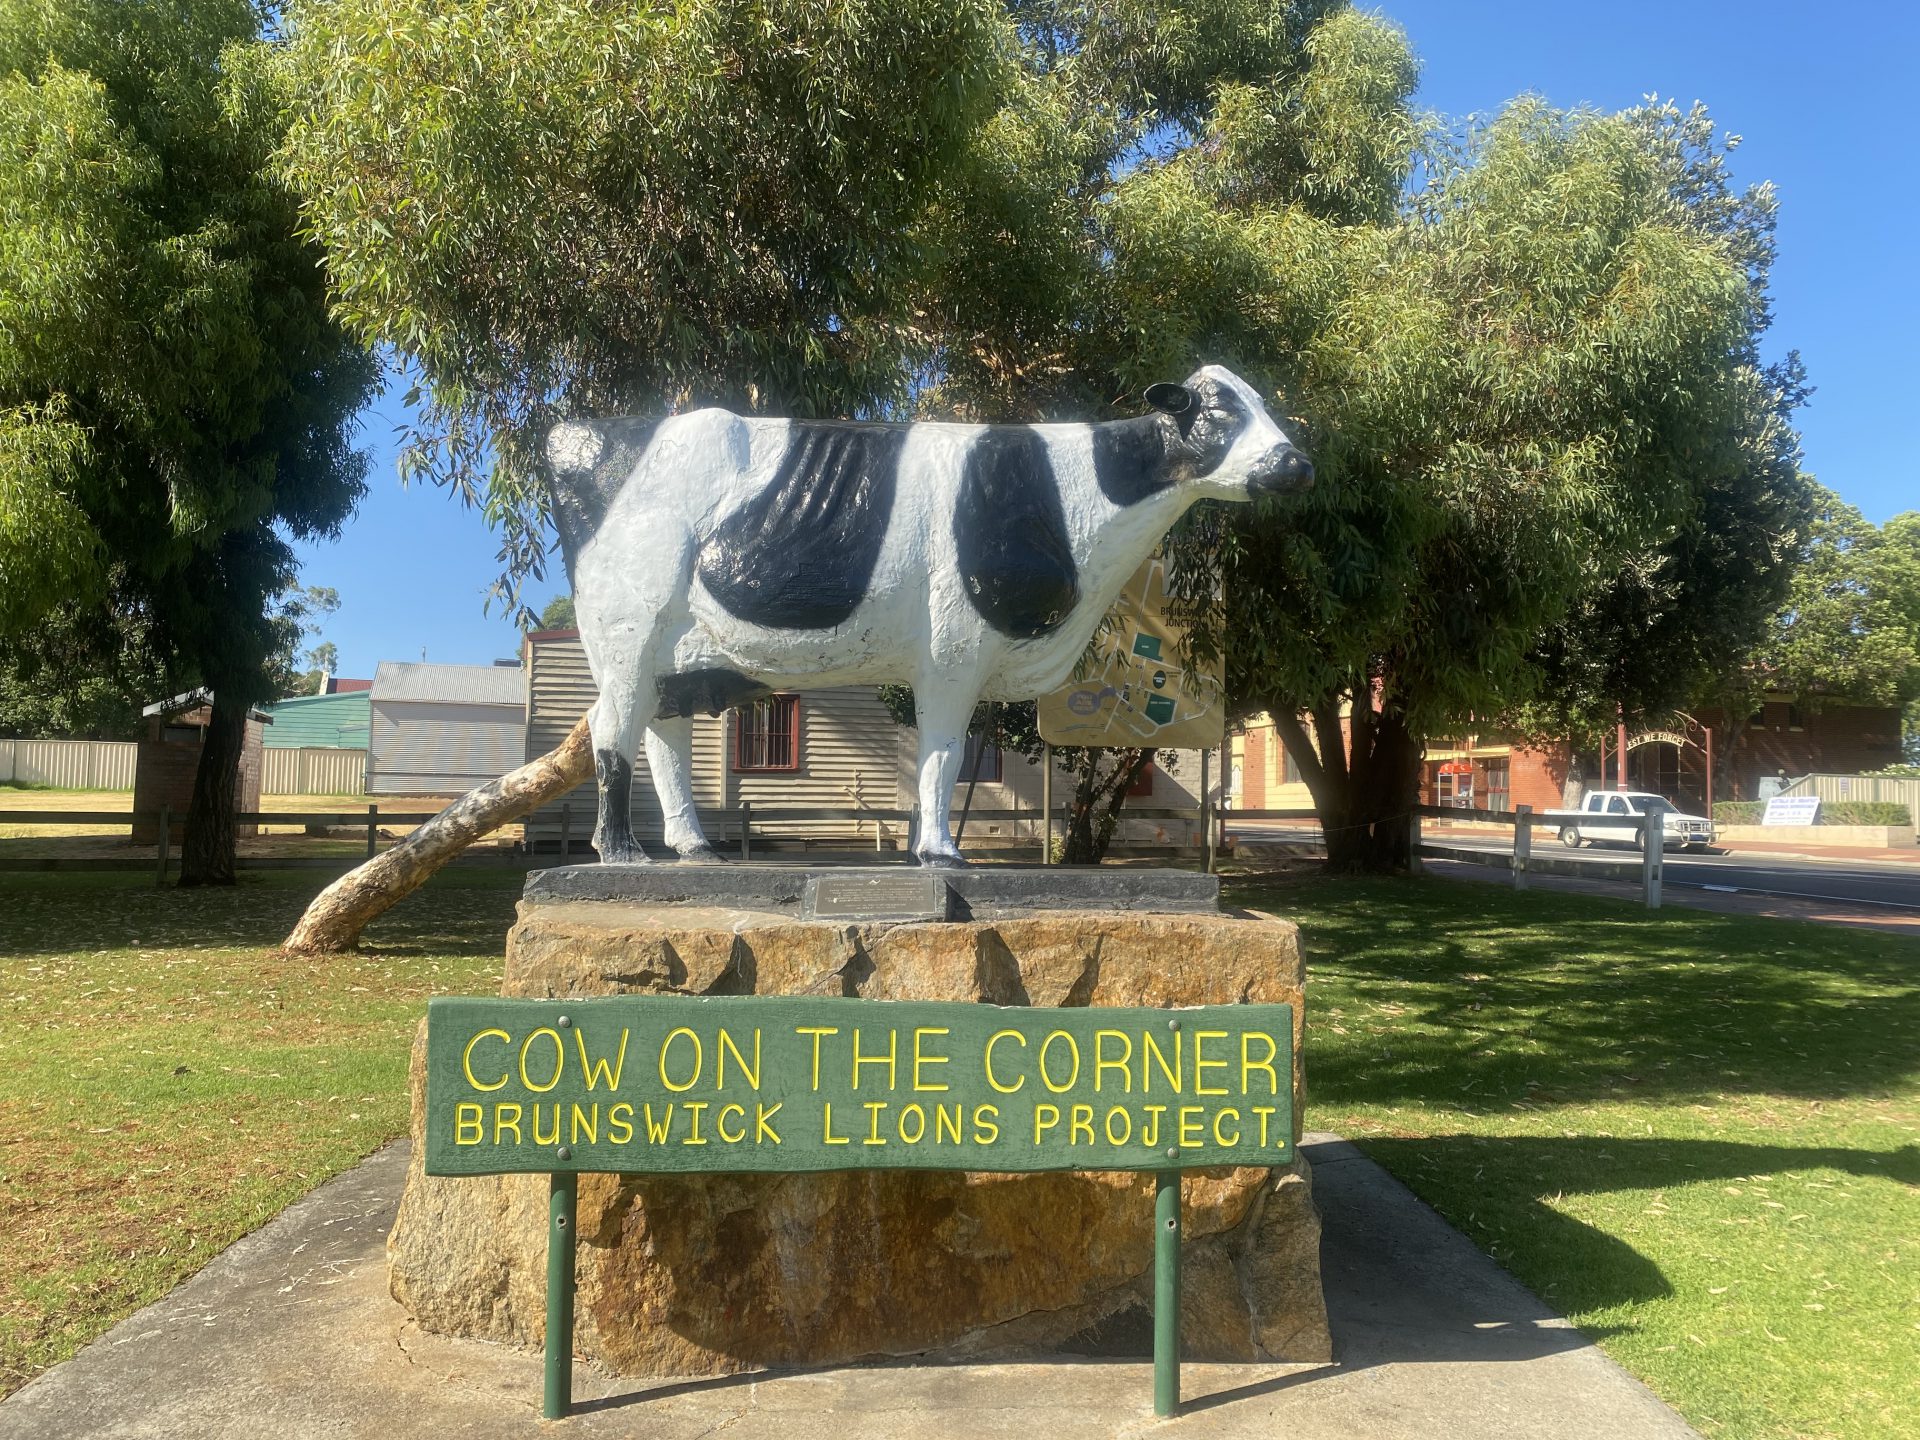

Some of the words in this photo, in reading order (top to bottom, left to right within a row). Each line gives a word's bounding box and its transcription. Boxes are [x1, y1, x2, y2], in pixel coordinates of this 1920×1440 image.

[1627, 736, 1641, 748] EST
[1643, 733, 1657, 742] WE
[463, 1028, 629, 1092] COW
[659, 1027, 761, 1092] ON
[796, 1027, 948, 1092] THE
[985, 1029, 1277, 1095] CORNER
[455, 1102, 781, 1145] BRUNSWICK
[824, 1102, 998, 1145] LIONS
[1035, 1103, 1284, 1147] PROJECT.
